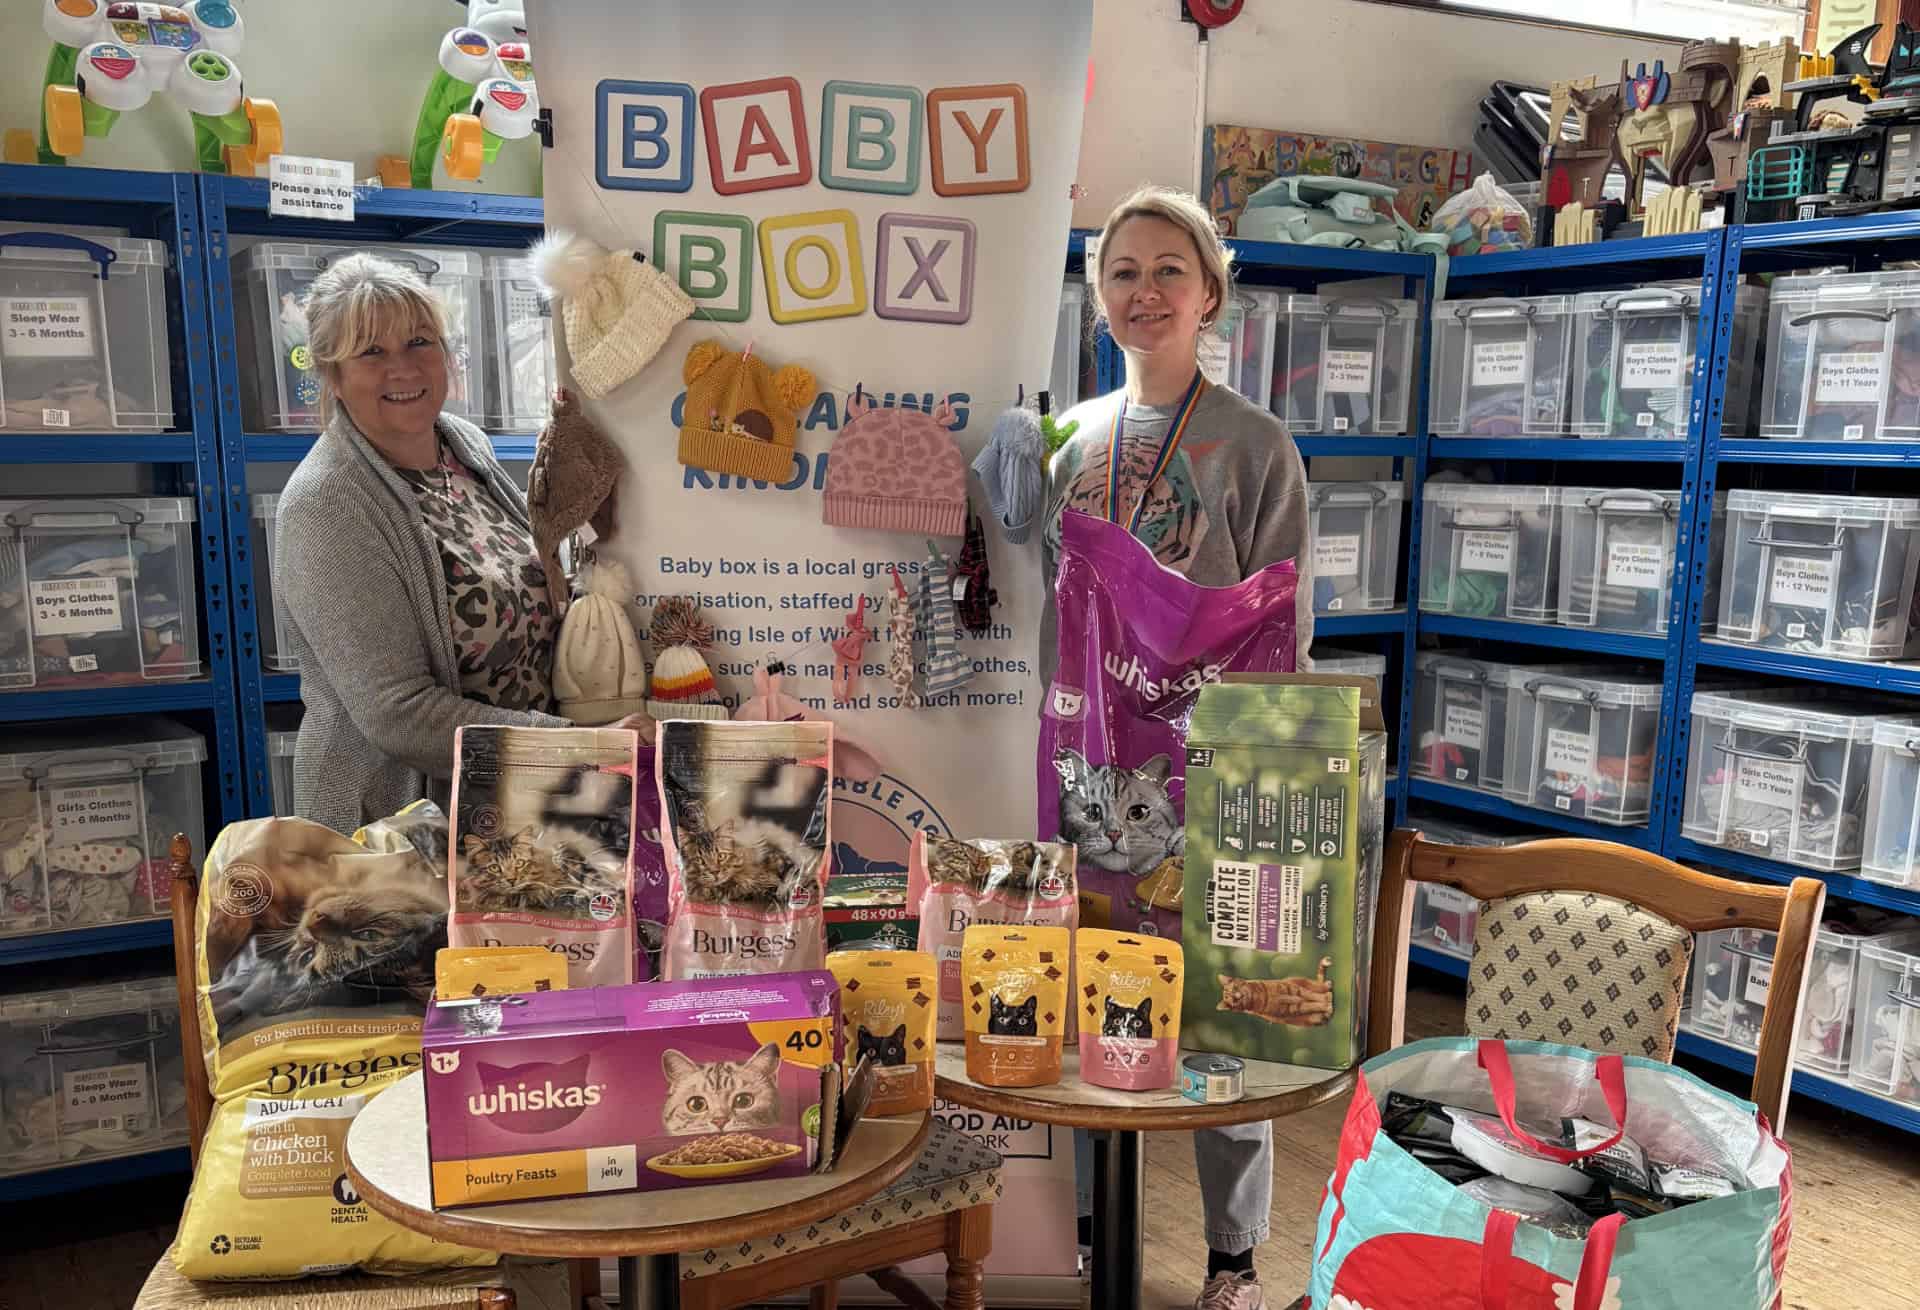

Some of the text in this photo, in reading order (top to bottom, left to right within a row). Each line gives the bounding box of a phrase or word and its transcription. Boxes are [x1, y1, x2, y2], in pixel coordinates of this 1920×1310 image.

[620, 101, 1006, 176] BABY
[271, 181, 353, 198] Please ask for
[281, 197, 344, 211] assistance
[677, 231, 953, 304] BOX
[10, 313, 80, 327] Sleep Wear
[40, 328, 85, 339] Months
[1626, 355, 1677, 365] Boys Clothes
[1648, 367, 1671, 375] Years
[1822, 367, 1879, 376] Boys Clothes
[1851, 379, 1877, 387] Years
[660, 557, 713, 577] Baby
[720, 557, 757, 574] box
[763, 557, 780, 574] is
[787, 562, 799, 574] a
[806, 557, 856, 574] local
[1631, 554, 1660, 564] Clothes
[1634, 567, 1655, 576] Years
[1797, 571, 1829, 582] Clothes
[1804, 584, 1828, 593] Years
[36, 592, 115, 606] Boys Clothes
[635, 592, 773, 611] orisation,
[780, 592, 853, 609] staffed
[40, 611, 48, 619] 3
[70, 607, 113, 618] Months
[749, 626, 785, 642] Isle
[792, 625, 812, 642] of
[971, 624, 1012, 641] with
[719, 658, 759, 676] suc
[968, 656, 1031, 676] othes,
[1104, 650, 1223, 702] whiskas
[833, 693, 871, 710] and
[877, 697, 900, 709] so
[967, 689, 1023, 706] more!
[1762, 771, 1794, 784] Clothes
[1769, 784, 1792, 796] Years
[57, 799, 133, 813] Girls Clothes
[89, 813, 131, 823] Months
[1217, 866, 1237, 940] COMPLETE
[1236, 868, 1251, 942] NUTRITION
[1317, 883, 1329, 929] Sainsbury's
[693, 929, 797, 960] Burgess
[254, 1033, 272, 1046] For
[274, 1023, 334, 1041] beautiful
[337, 1023, 365, 1034] cats
[367, 1022, 409, 1033] inside
[785, 1029, 823, 1052] 40
[436, 1055, 455, 1072] 1+
[73, 1078, 139, 1094] Sleep Wear
[99, 1090, 141, 1102] Months
[468, 1079, 601, 1117] whiskas
[259, 1096, 345, 1117] ADULT CAT
[991, 1112, 1033, 1131] AID
[253, 1133, 328, 1152] Chicken
[250, 1148, 335, 1167] with Duck
[607, 1155, 617, 1167] in
[465, 1166, 557, 1187] Poultry Feasts
[600, 1164, 624, 1179] jelly
[331, 1207, 368, 1215] DENTAL
[331, 1215, 368, 1224] HEALTH
